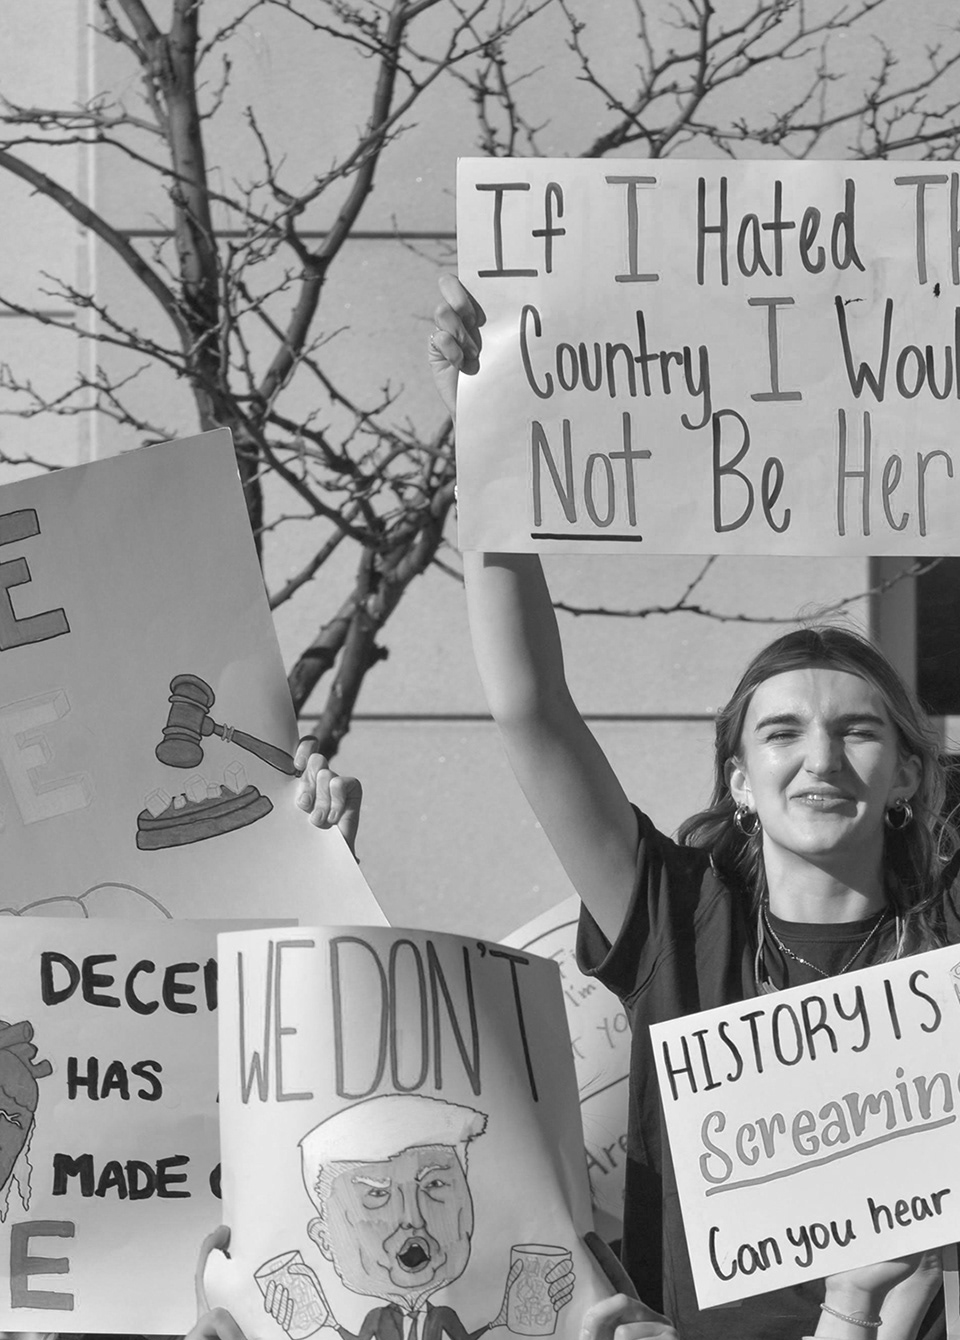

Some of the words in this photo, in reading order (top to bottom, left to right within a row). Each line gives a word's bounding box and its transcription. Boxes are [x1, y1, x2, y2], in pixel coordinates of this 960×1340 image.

[476, 182, 565, 278] If
[605, 175, 660, 282] I
[697, 176, 866, 286] Hated
[520, 304, 714, 430] Country
[748, 296, 803, 401] I
[532, 411, 653, 530] Not
[712, 409, 792, 533] Be
[236, 939, 316, 1103] WE
[329, 935, 540, 1104] DON'T
[662, 985, 870, 1100] HISTORY
[883, 970, 942, 1041] IS
[67, 1056, 162, 1101] HAS
[52, 1153, 192, 1200] MADE
[708, 1226, 783, 1281] Can
[786, 1218, 857, 1268] you
[867, 1187, 951, 1234] hear
